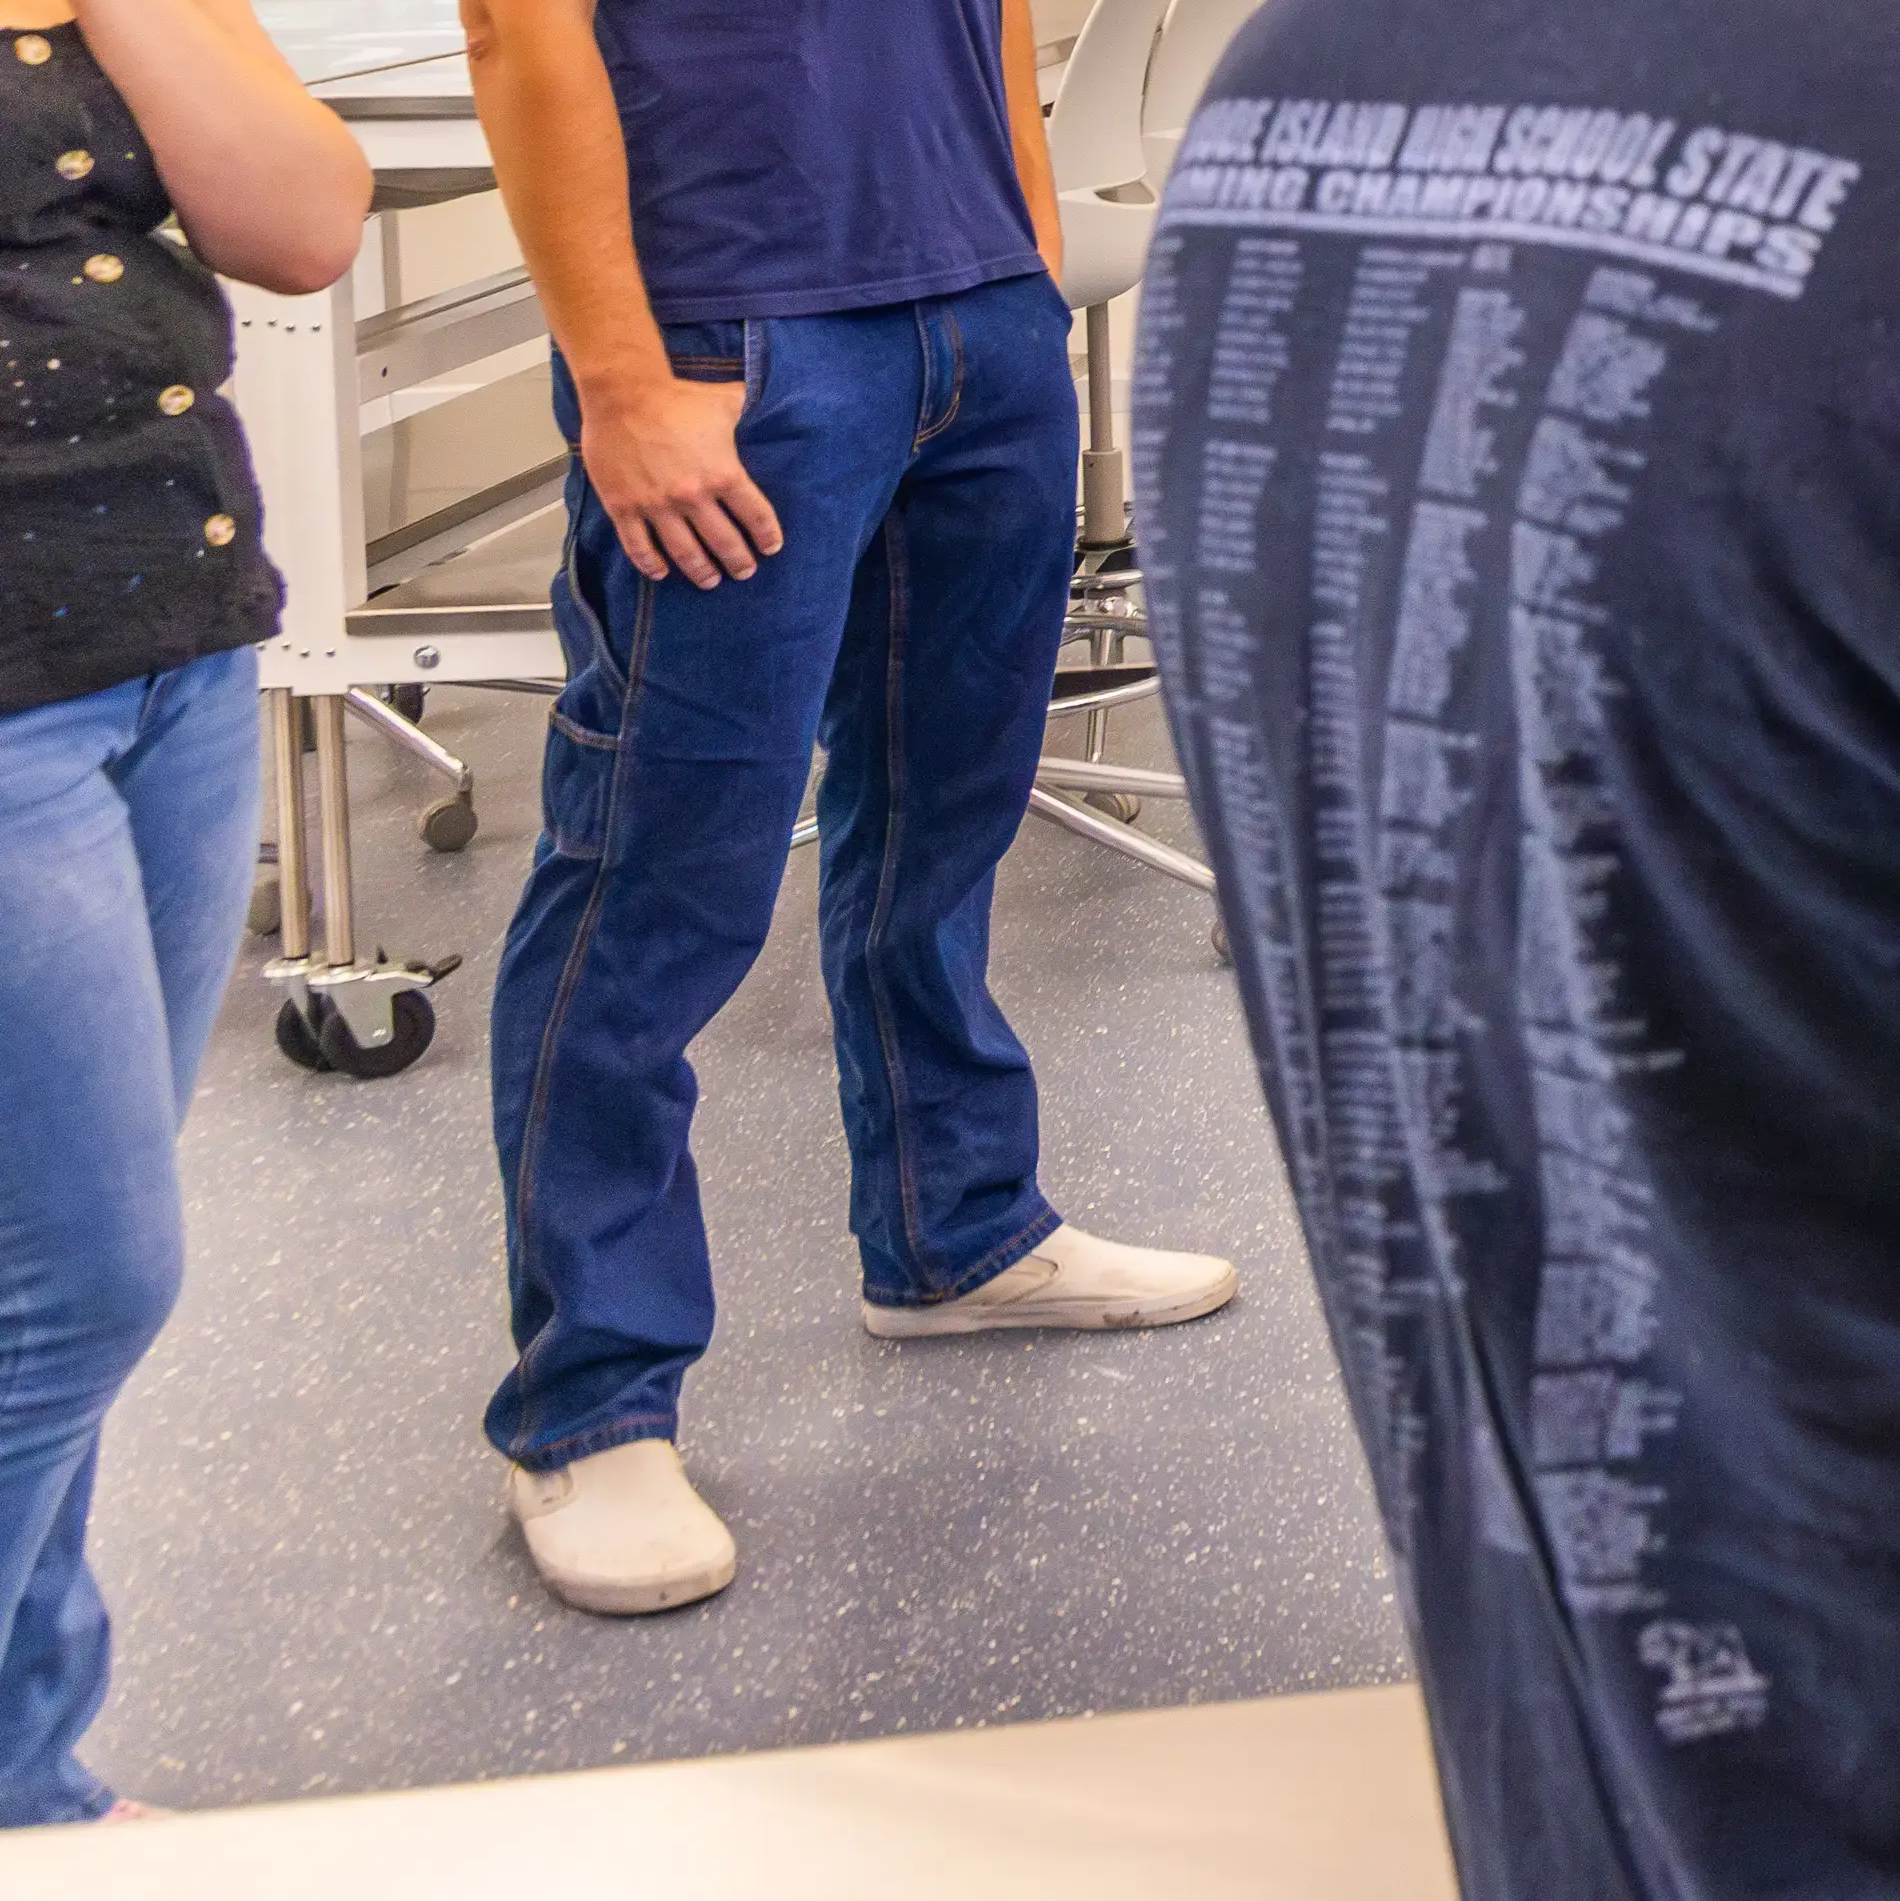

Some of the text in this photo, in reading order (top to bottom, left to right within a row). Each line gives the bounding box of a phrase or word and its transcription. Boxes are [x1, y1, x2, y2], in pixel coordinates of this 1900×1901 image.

[1320, 166, 1826, 277] CHAMPIONSHIPS
[1496, 106, 1680, 187] SCHOOL
[1665, 126, 1862, 233] STATE
